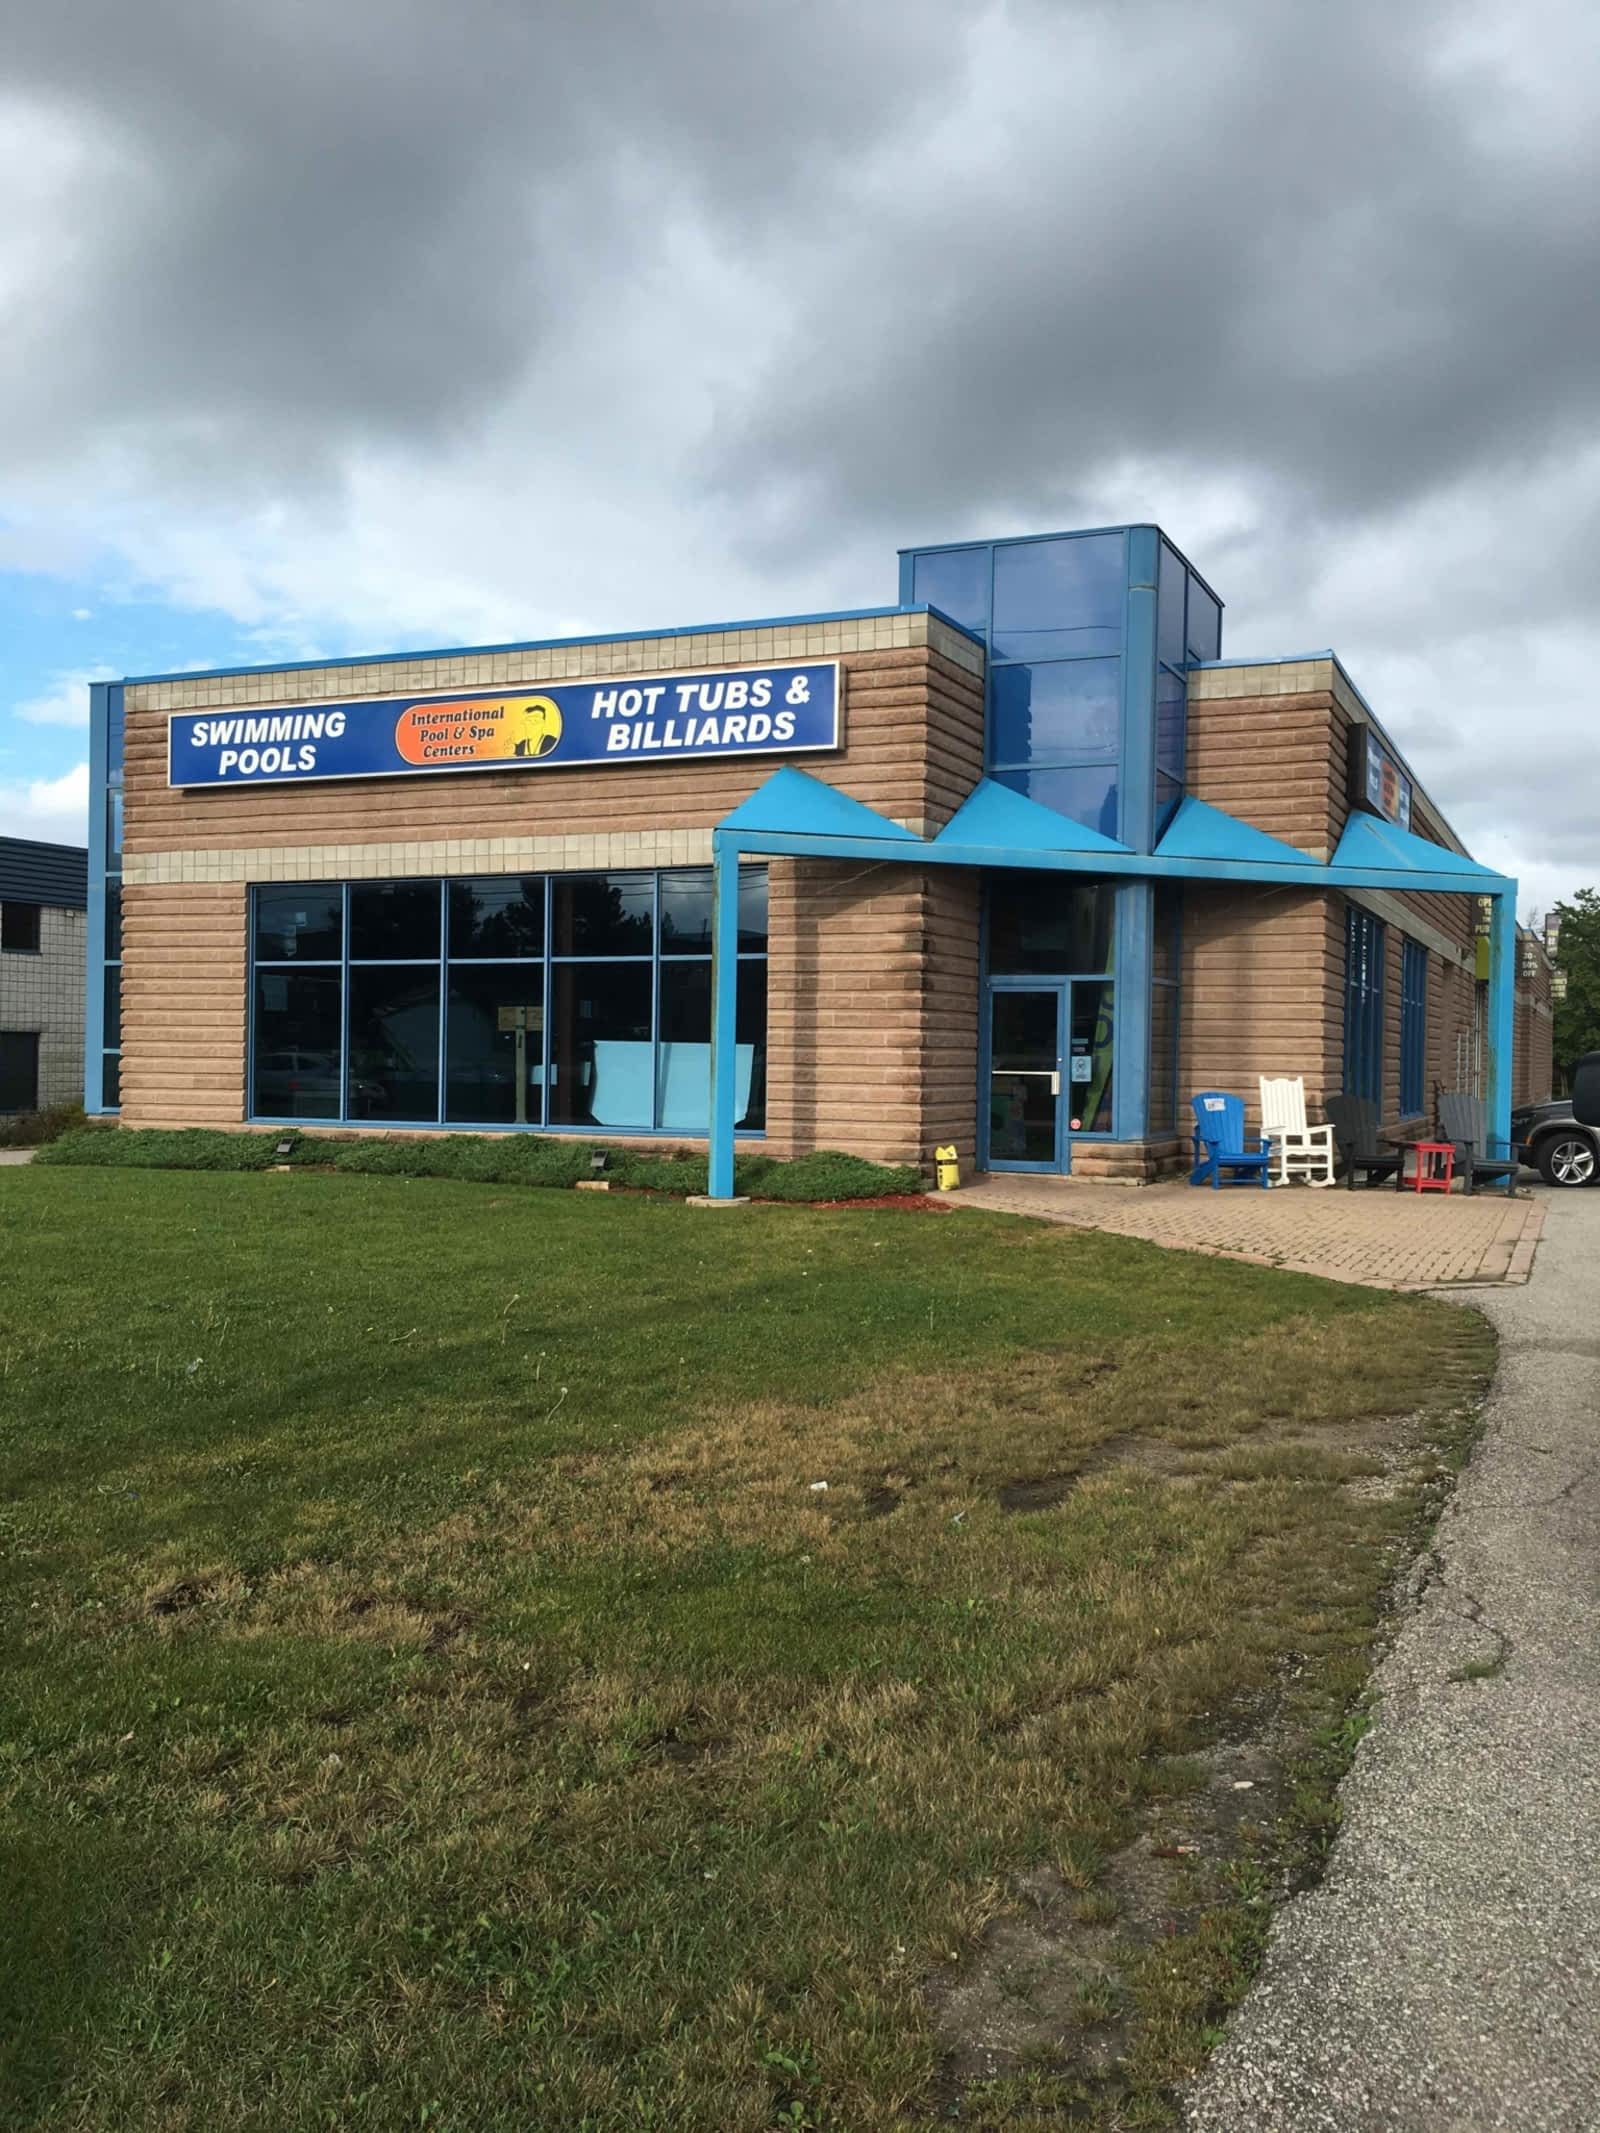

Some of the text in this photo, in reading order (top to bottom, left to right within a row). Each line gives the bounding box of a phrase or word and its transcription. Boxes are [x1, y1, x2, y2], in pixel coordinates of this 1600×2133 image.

[592, 675, 811, 719] HOT TUBS &
[190, 712, 346, 747] SWIMMING
[412, 706, 504, 726] International
[606, 711, 796, 751] BILLIARDS
[420, 725, 495, 742] Pool & Spa
[219, 745, 316, 775] POOLS
[423, 745, 475, 757] Centers
